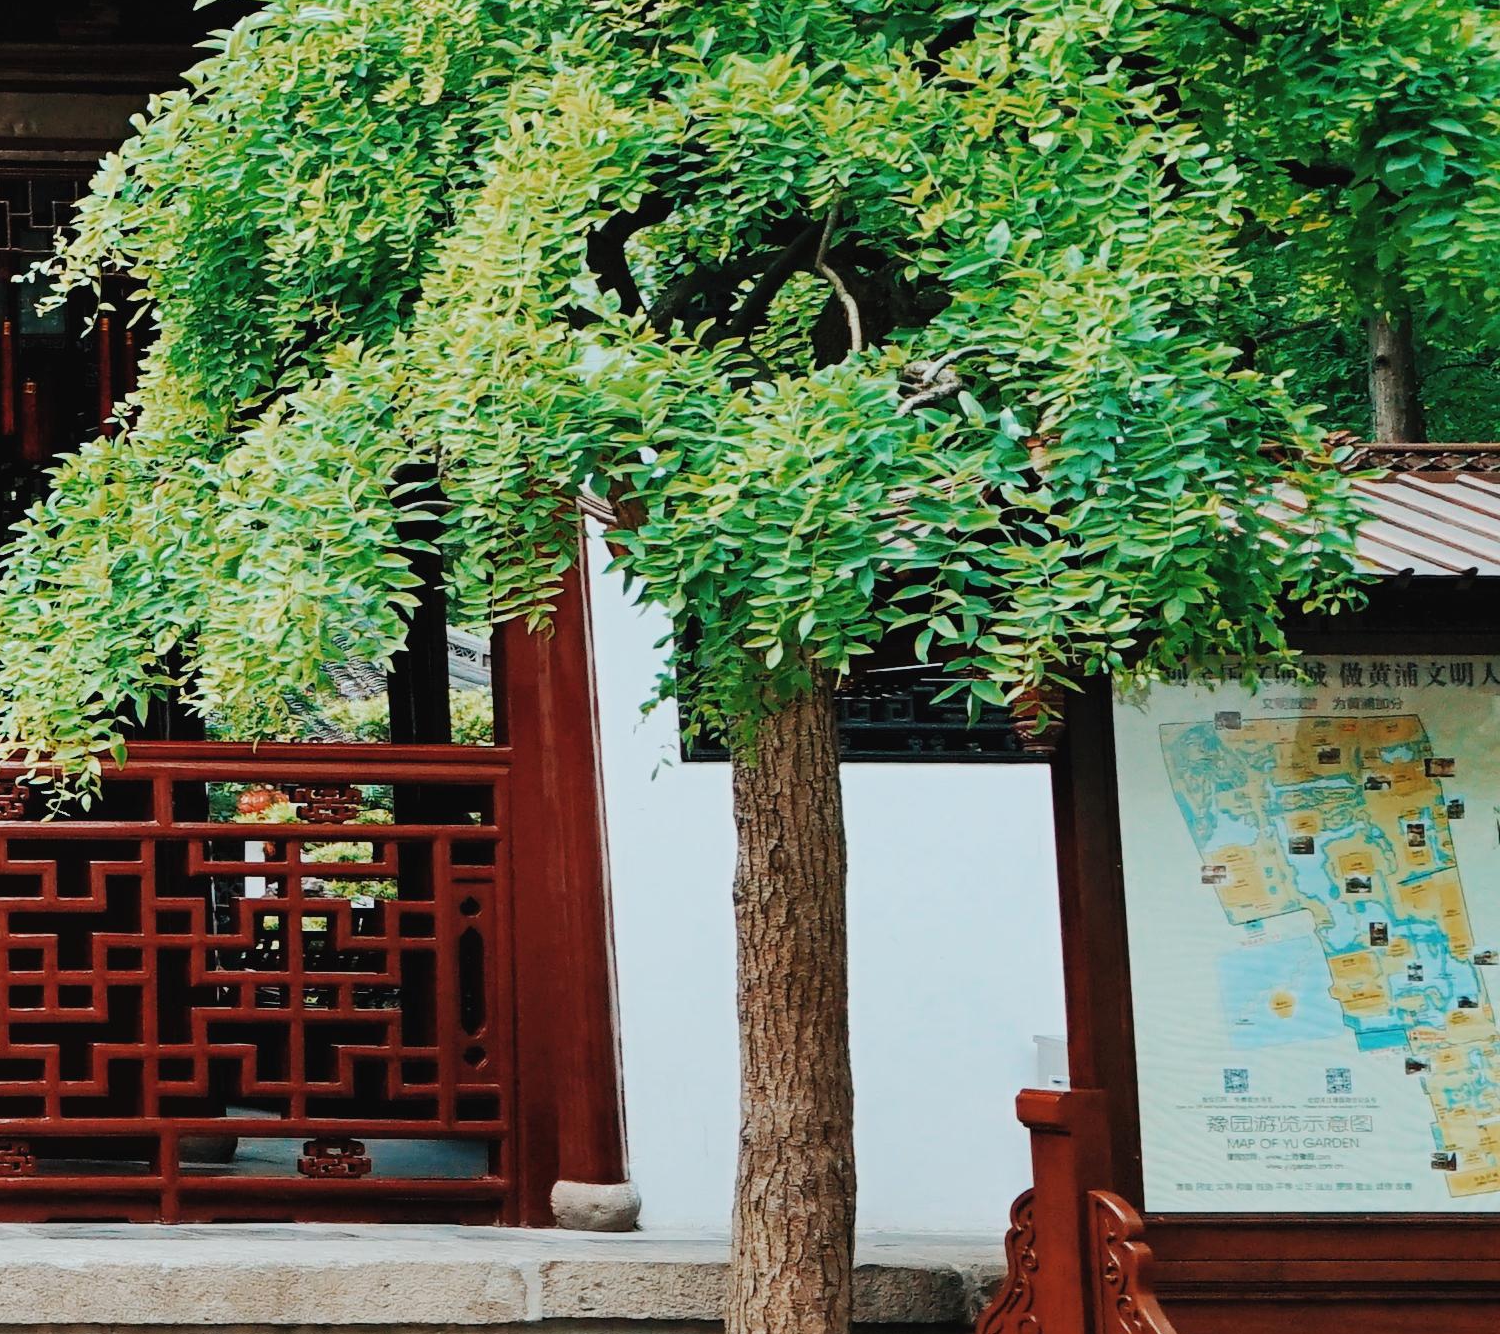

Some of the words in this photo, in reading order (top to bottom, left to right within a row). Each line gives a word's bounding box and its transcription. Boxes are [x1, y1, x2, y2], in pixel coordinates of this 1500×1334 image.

[1207, 1115, 1373, 1133] 豫园游览示意图
[1227, 1139, 1255, 1149] MAP
[1260, 1138, 1277, 1149] OF
[1283, 1138, 1299, 1149] YU
[1303, 1137, 1360, 1149] GARDEN
